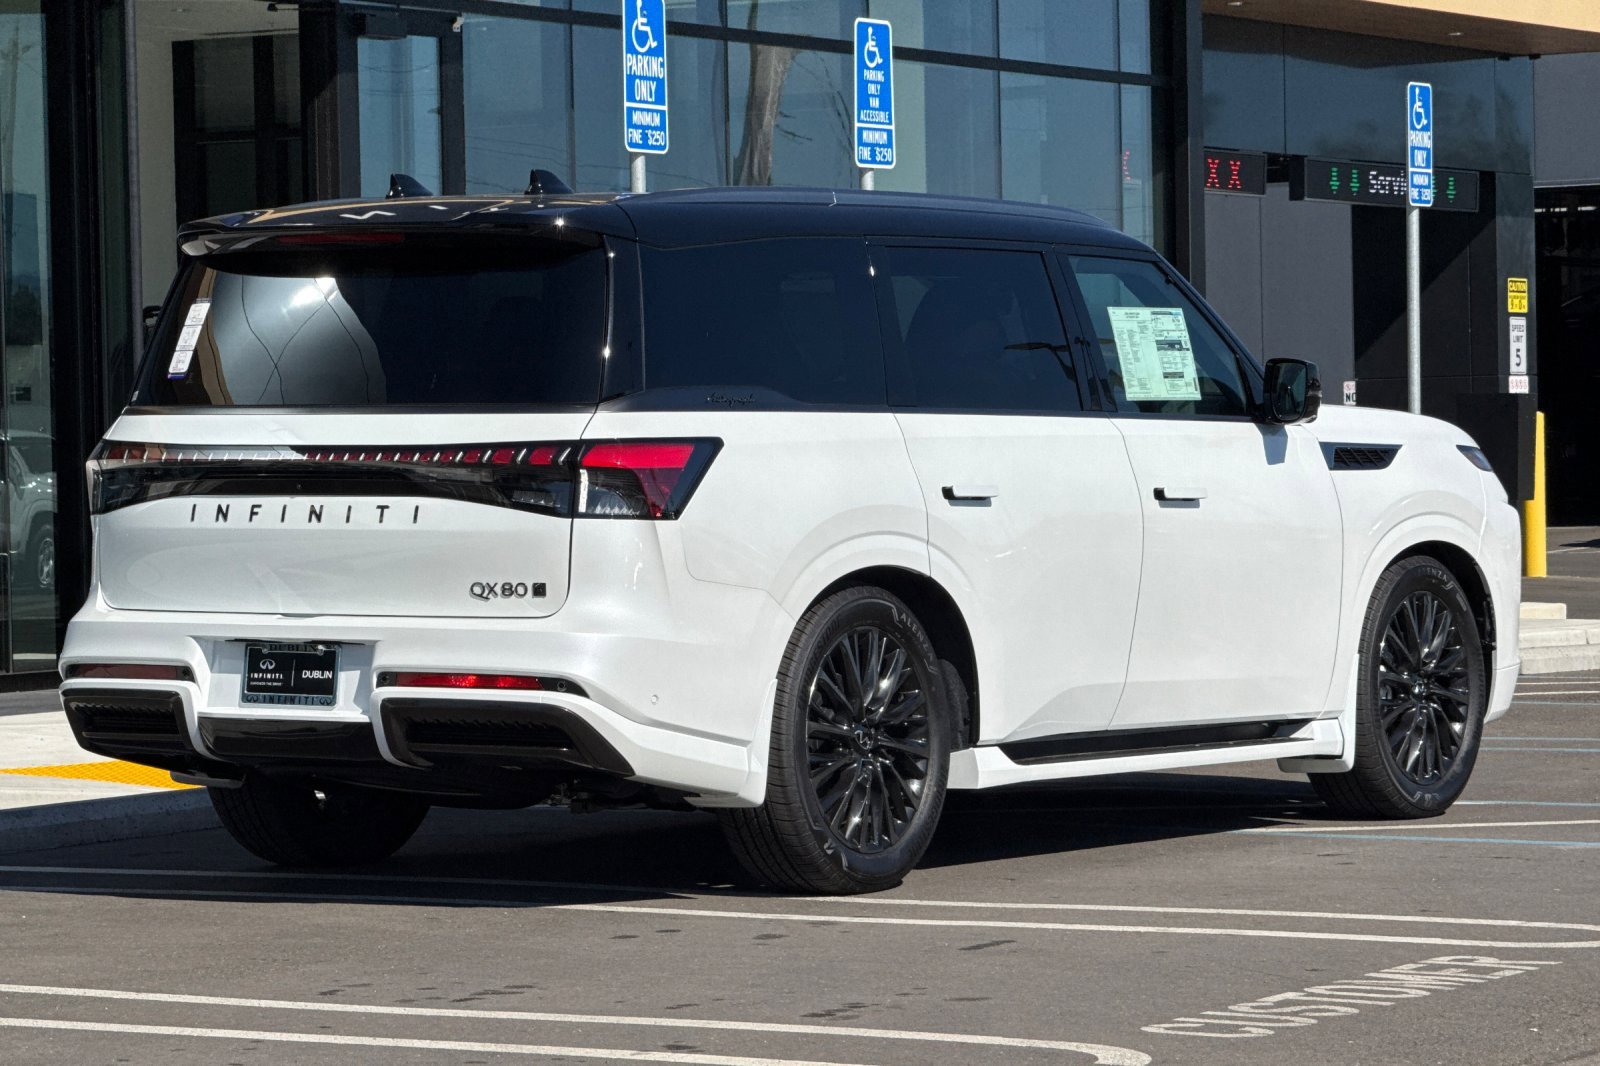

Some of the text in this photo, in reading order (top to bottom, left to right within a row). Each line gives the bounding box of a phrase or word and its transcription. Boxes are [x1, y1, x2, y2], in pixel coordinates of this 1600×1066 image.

[627, 53, 664, 79] PARKING
[863, 69, 885, 83] PARKING
[634, 79, 657, 102] ONLY
[867, 83, 881, 96] ONLY
[869, 97, 880, 108] VAN
[632, 110, 661, 127] MINIMUM
[860, 111, 889, 123] ACCESSIBLE
[628, 128, 665, 146] FINE $250
[862, 130, 888, 144] MINIMUM
[1410, 130, 1431, 148] PARKING
[858, 146, 892, 162] FINE $250
[1414, 149, 1427, 167] ONLY
[1368, 170, 1407, 196] Servi
[1511, 324, 1525, 332] SPEED
[1513, 335, 1524, 343] LIMIT
[1515, 348, 1522, 367] 5
[190, 503, 420, 524] INFINITI
[469, 582, 528, 601] QX80
[250, 672, 283, 680] INFINITI
[302, 669, 333, 679] DUBLIN
[263, 695, 315, 705] INFINITI
[1139, 955, 1563, 1038] CUSTOMER
